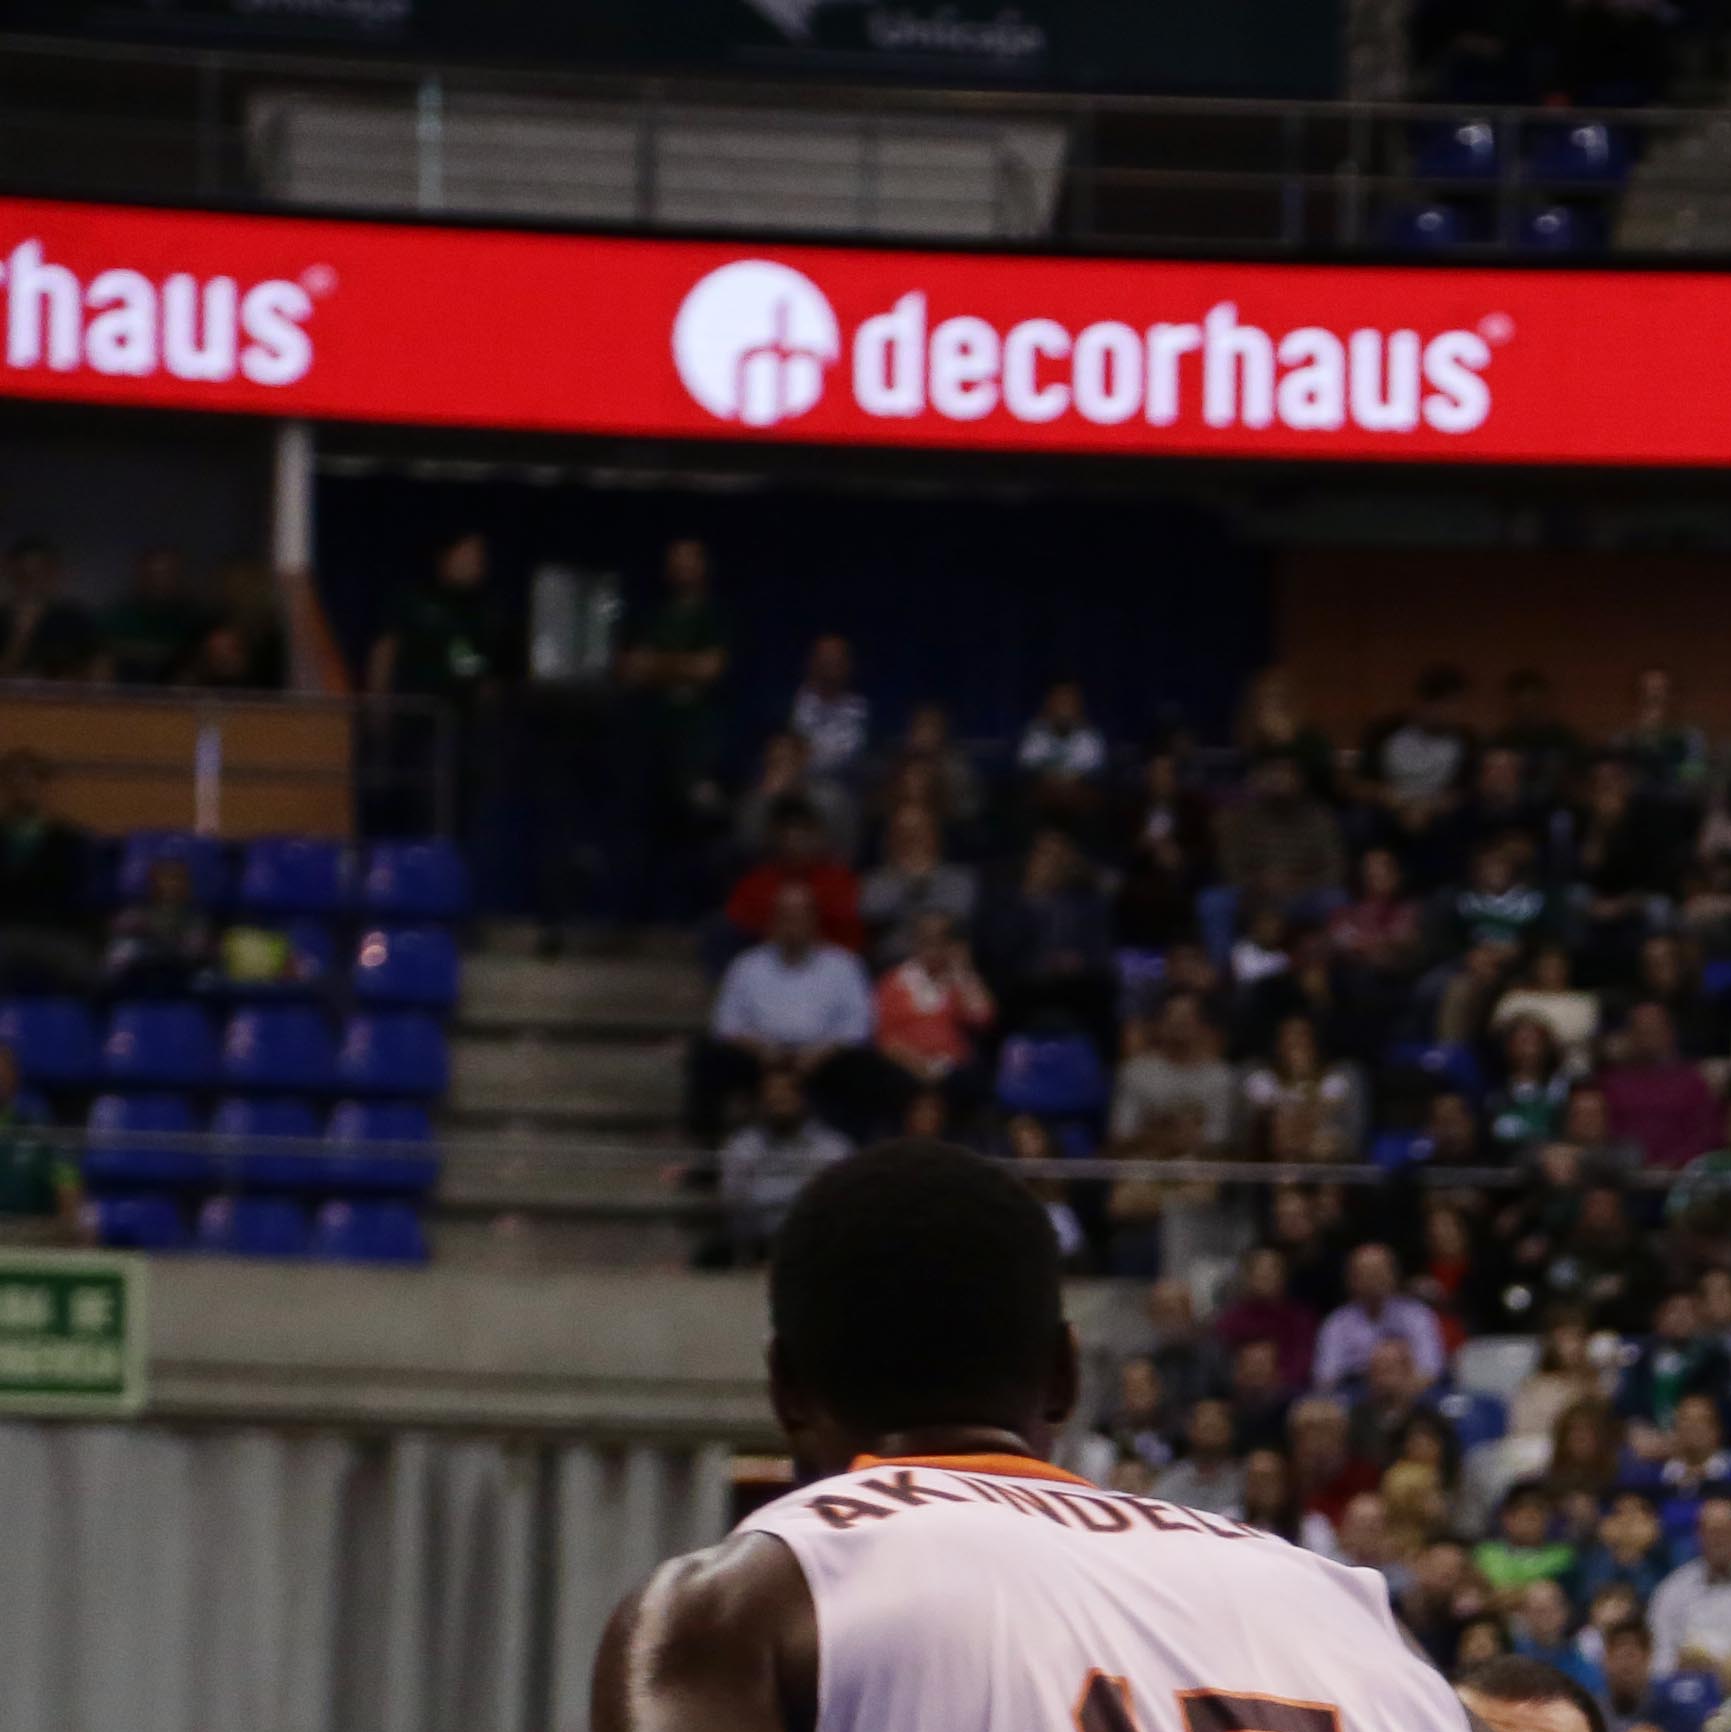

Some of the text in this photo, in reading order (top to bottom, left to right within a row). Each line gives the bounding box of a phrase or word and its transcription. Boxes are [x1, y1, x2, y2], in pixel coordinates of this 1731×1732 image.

[0, 238, 314, 388] haus
[852, 291, 1491, 436] decorhaus
[806, 1470, 1265, 1539] AKINDEL
